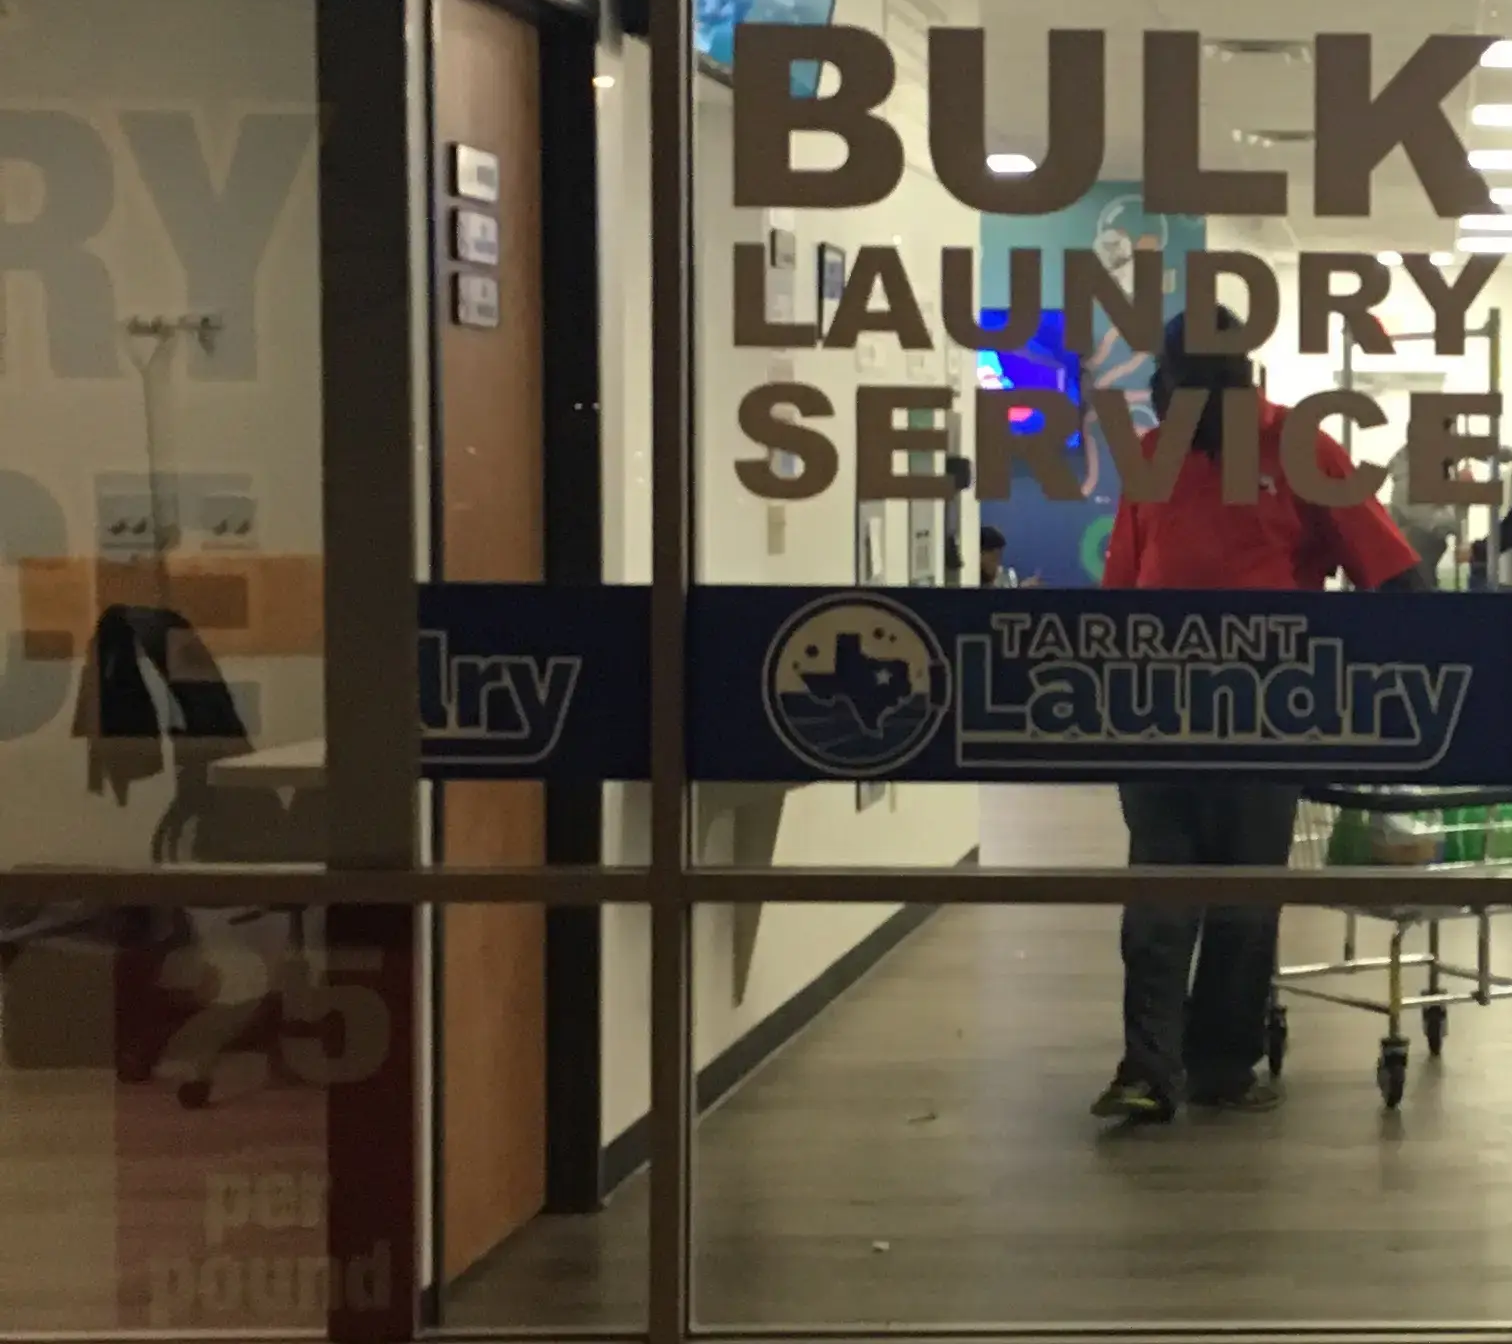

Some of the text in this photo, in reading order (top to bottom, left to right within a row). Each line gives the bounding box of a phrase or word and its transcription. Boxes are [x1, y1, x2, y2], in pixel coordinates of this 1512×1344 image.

[733, 23, 1507, 217] BULK
[733, 242, 1507, 356] LAUNDRY
[733, 382, 1503, 505] SERVICE
[991, 612, 1307, 659] TARRANT
[955, 633, 1472, 770] Laundry
[155, 945, 391, 1085] 25
[147, 1239, 393, 1324] pound
